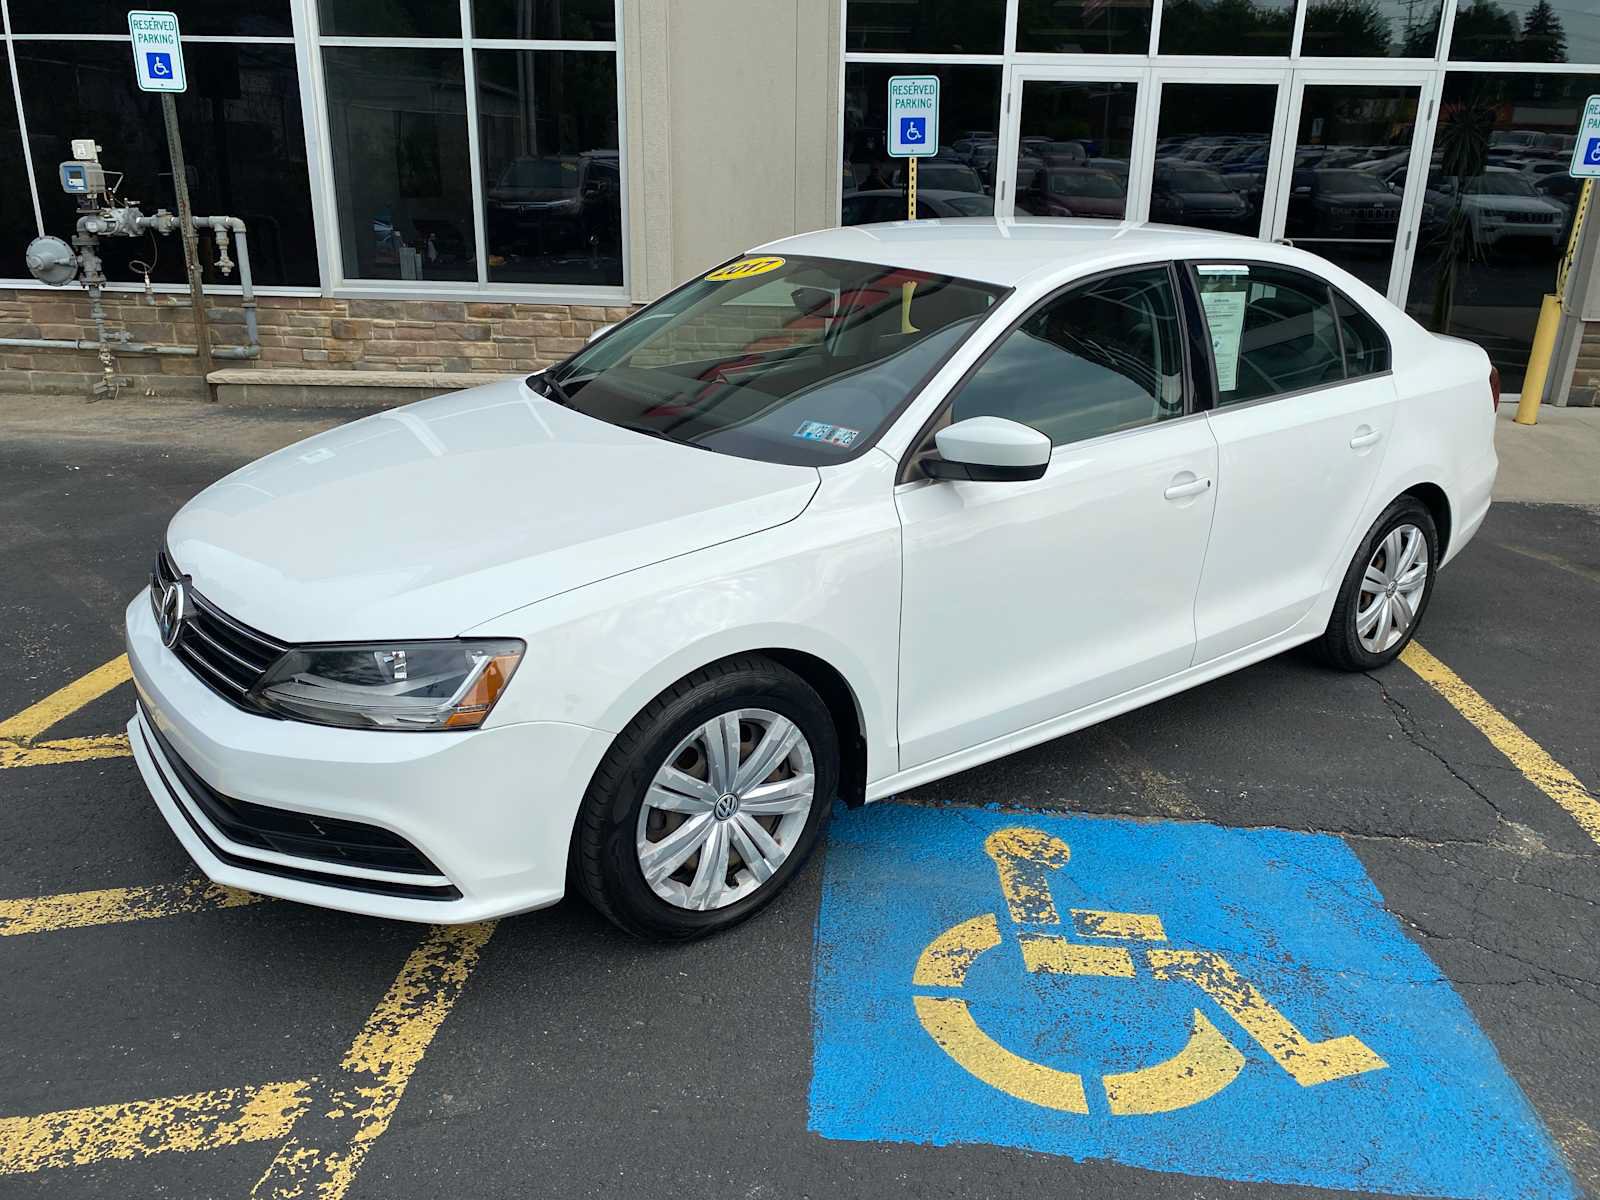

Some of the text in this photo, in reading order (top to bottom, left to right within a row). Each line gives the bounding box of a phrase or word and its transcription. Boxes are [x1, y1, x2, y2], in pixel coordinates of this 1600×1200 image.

[133, 20, 174, 31] RESERVED
[138, 34, 174, 44] PARKING
[892, 85, 934, 95] RESERVED
[896, 98, 932, 108] PARKING
